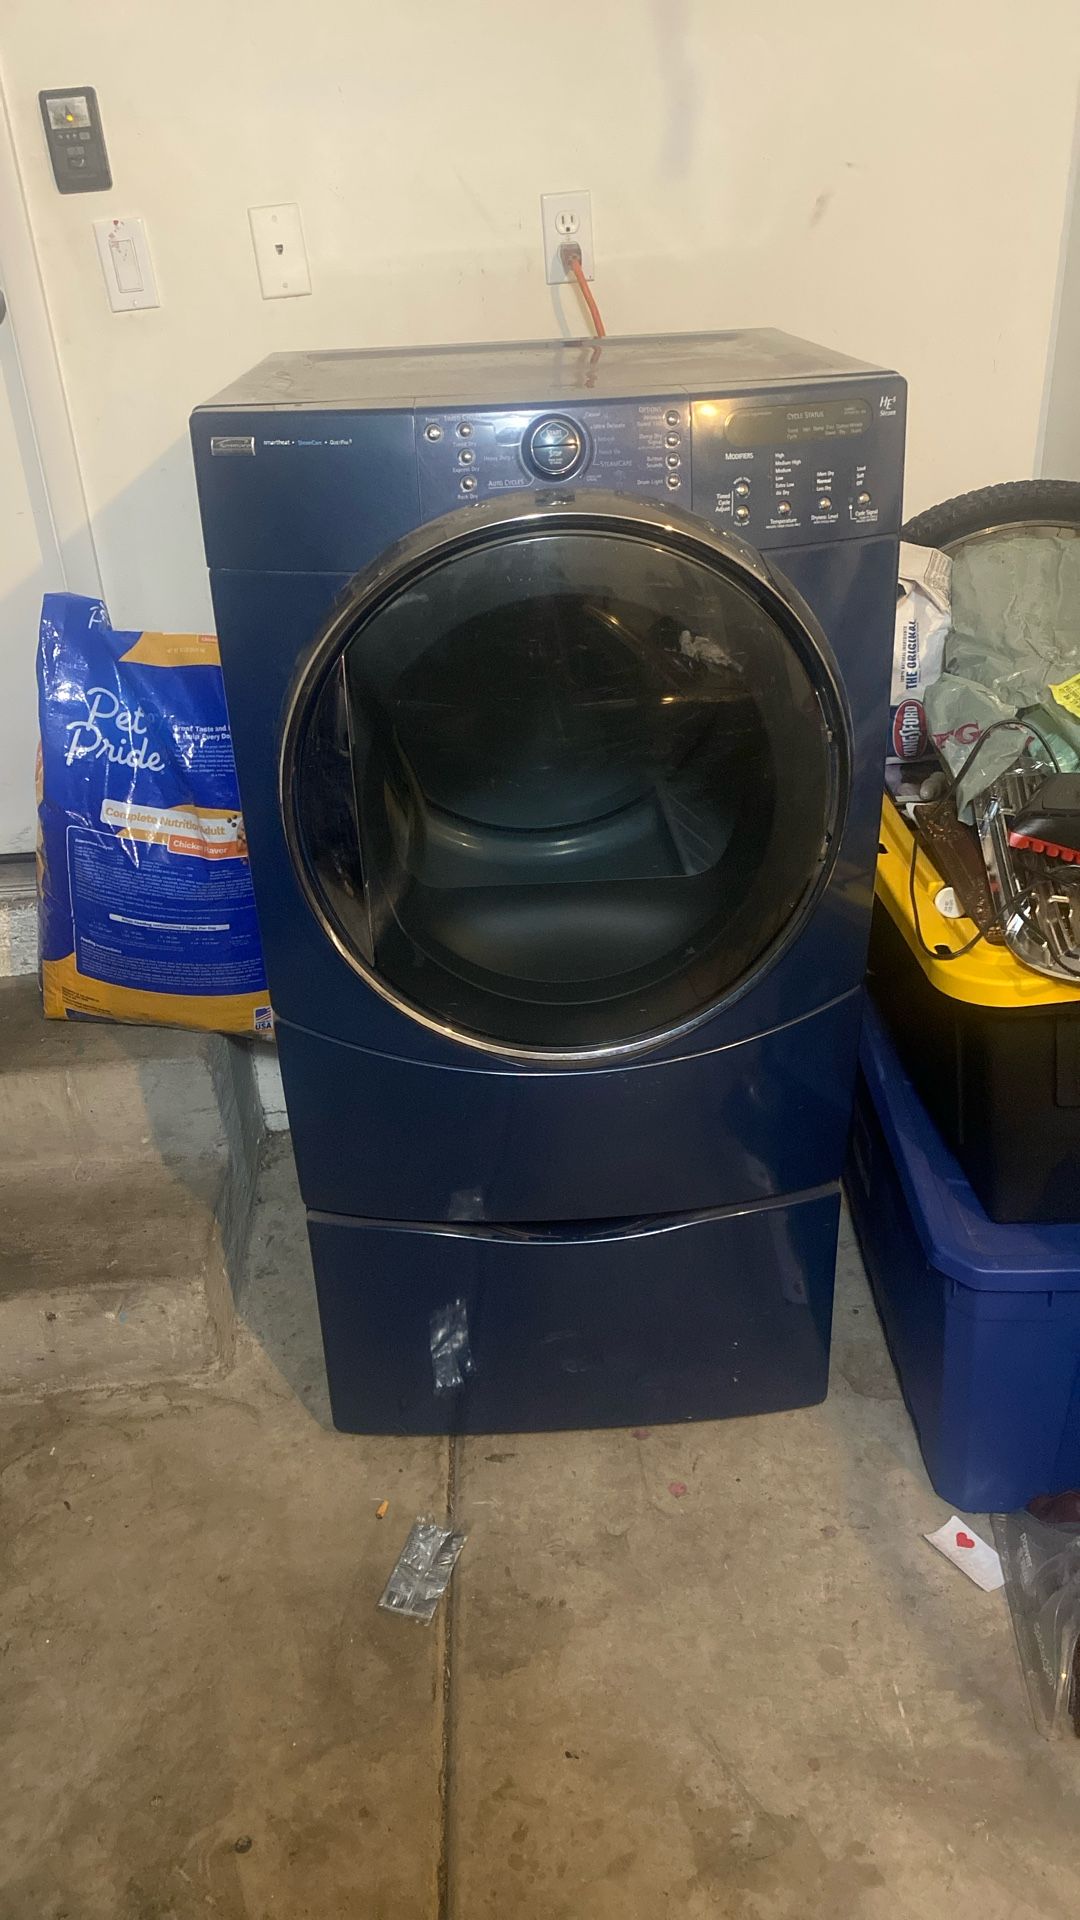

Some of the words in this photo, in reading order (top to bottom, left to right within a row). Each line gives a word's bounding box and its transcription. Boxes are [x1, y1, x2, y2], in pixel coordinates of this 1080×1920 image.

[786, 411, 803, 420] CYCLE
[804, 410, 825, 419] STATUS
[725, 452, 754, 460] MODIFIERS
[906, 619, 918, 669] ORIGINAL
[905, 670, 918, 690] THE
[87, 687, 147, 734] Pet
[66, 721, 165, 771] Pride
[899, 705, 922, 757] KINGSFORD
[105, 806, 158, 825] Complete
